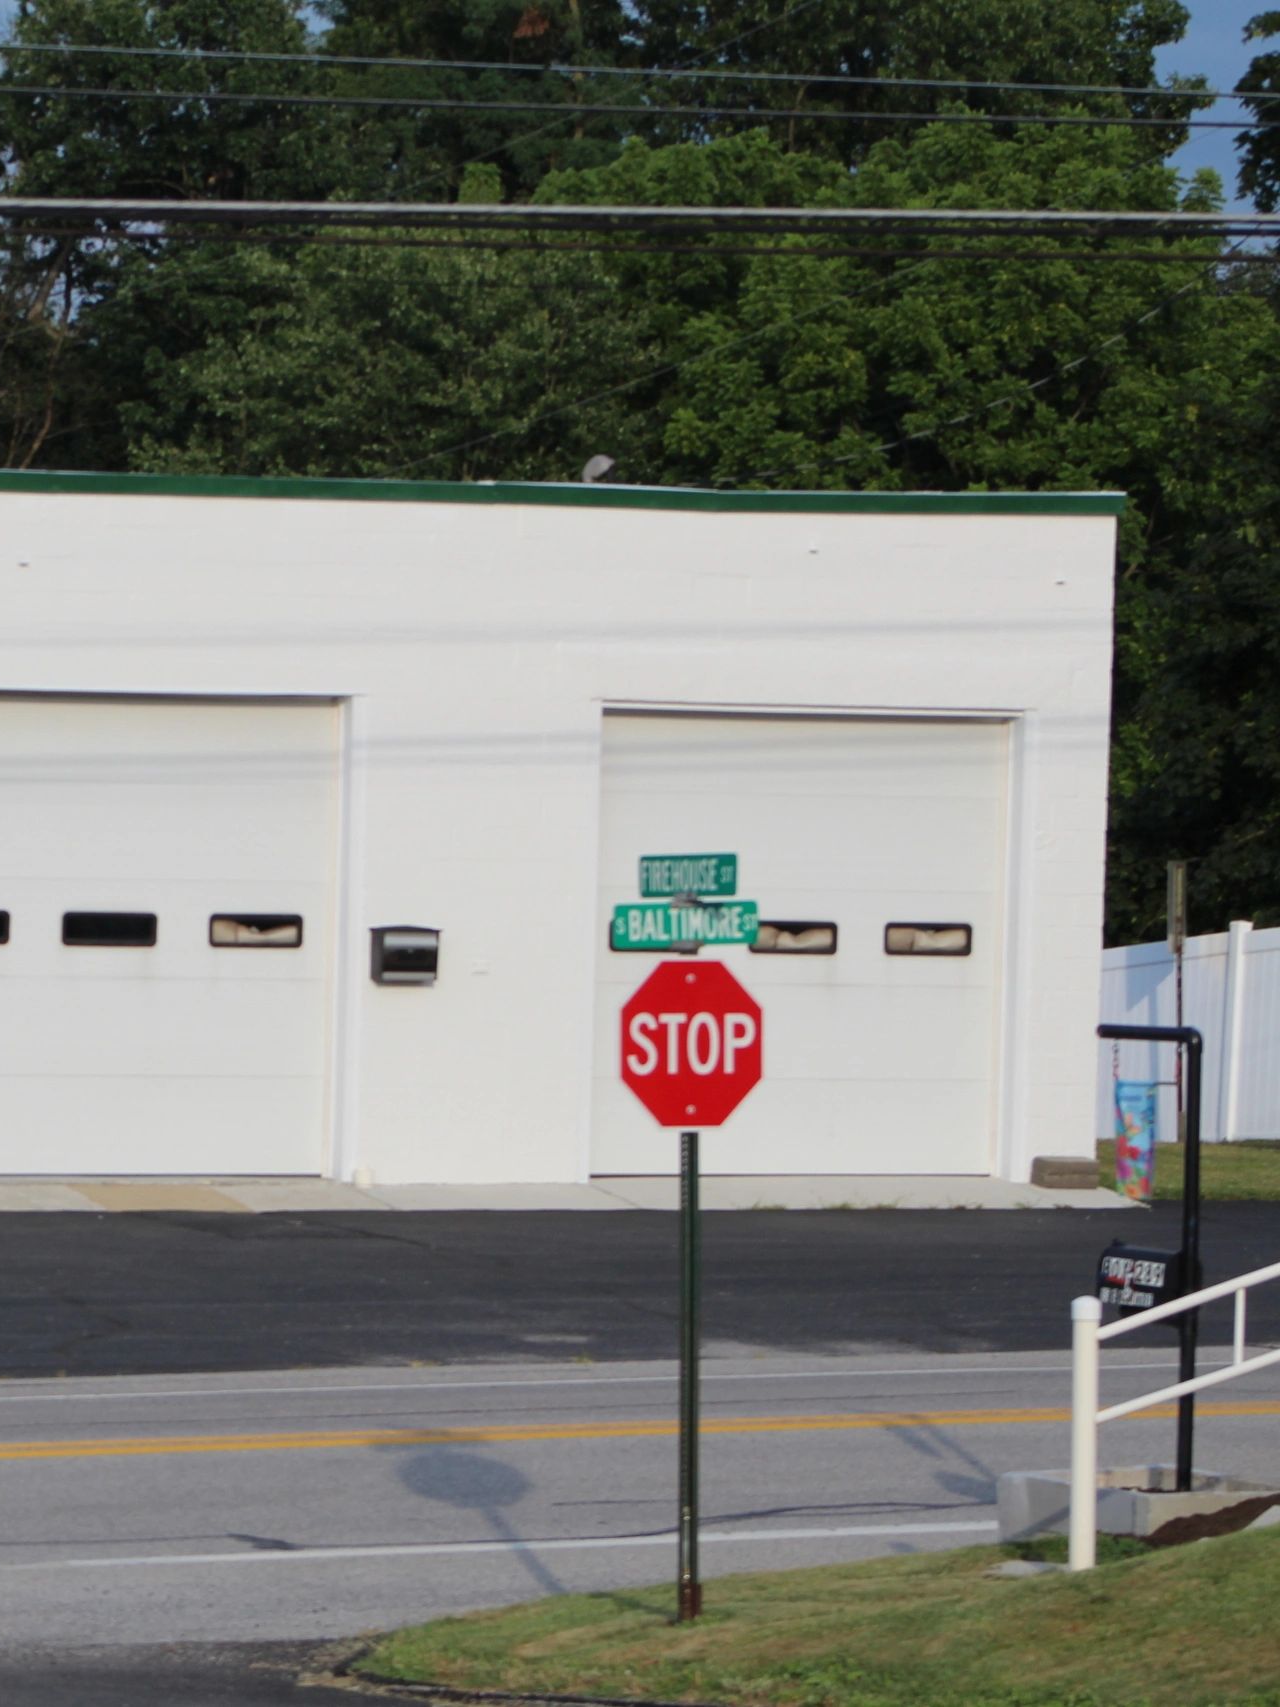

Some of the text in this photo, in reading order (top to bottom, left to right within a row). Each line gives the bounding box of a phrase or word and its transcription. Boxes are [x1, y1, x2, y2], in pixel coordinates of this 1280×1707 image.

[641, 859, 718, 892] FIREHOUSE
[615, 907, 757, 942] S BALTIMORE ST
[626, 1012, 756, 1076] STOP
